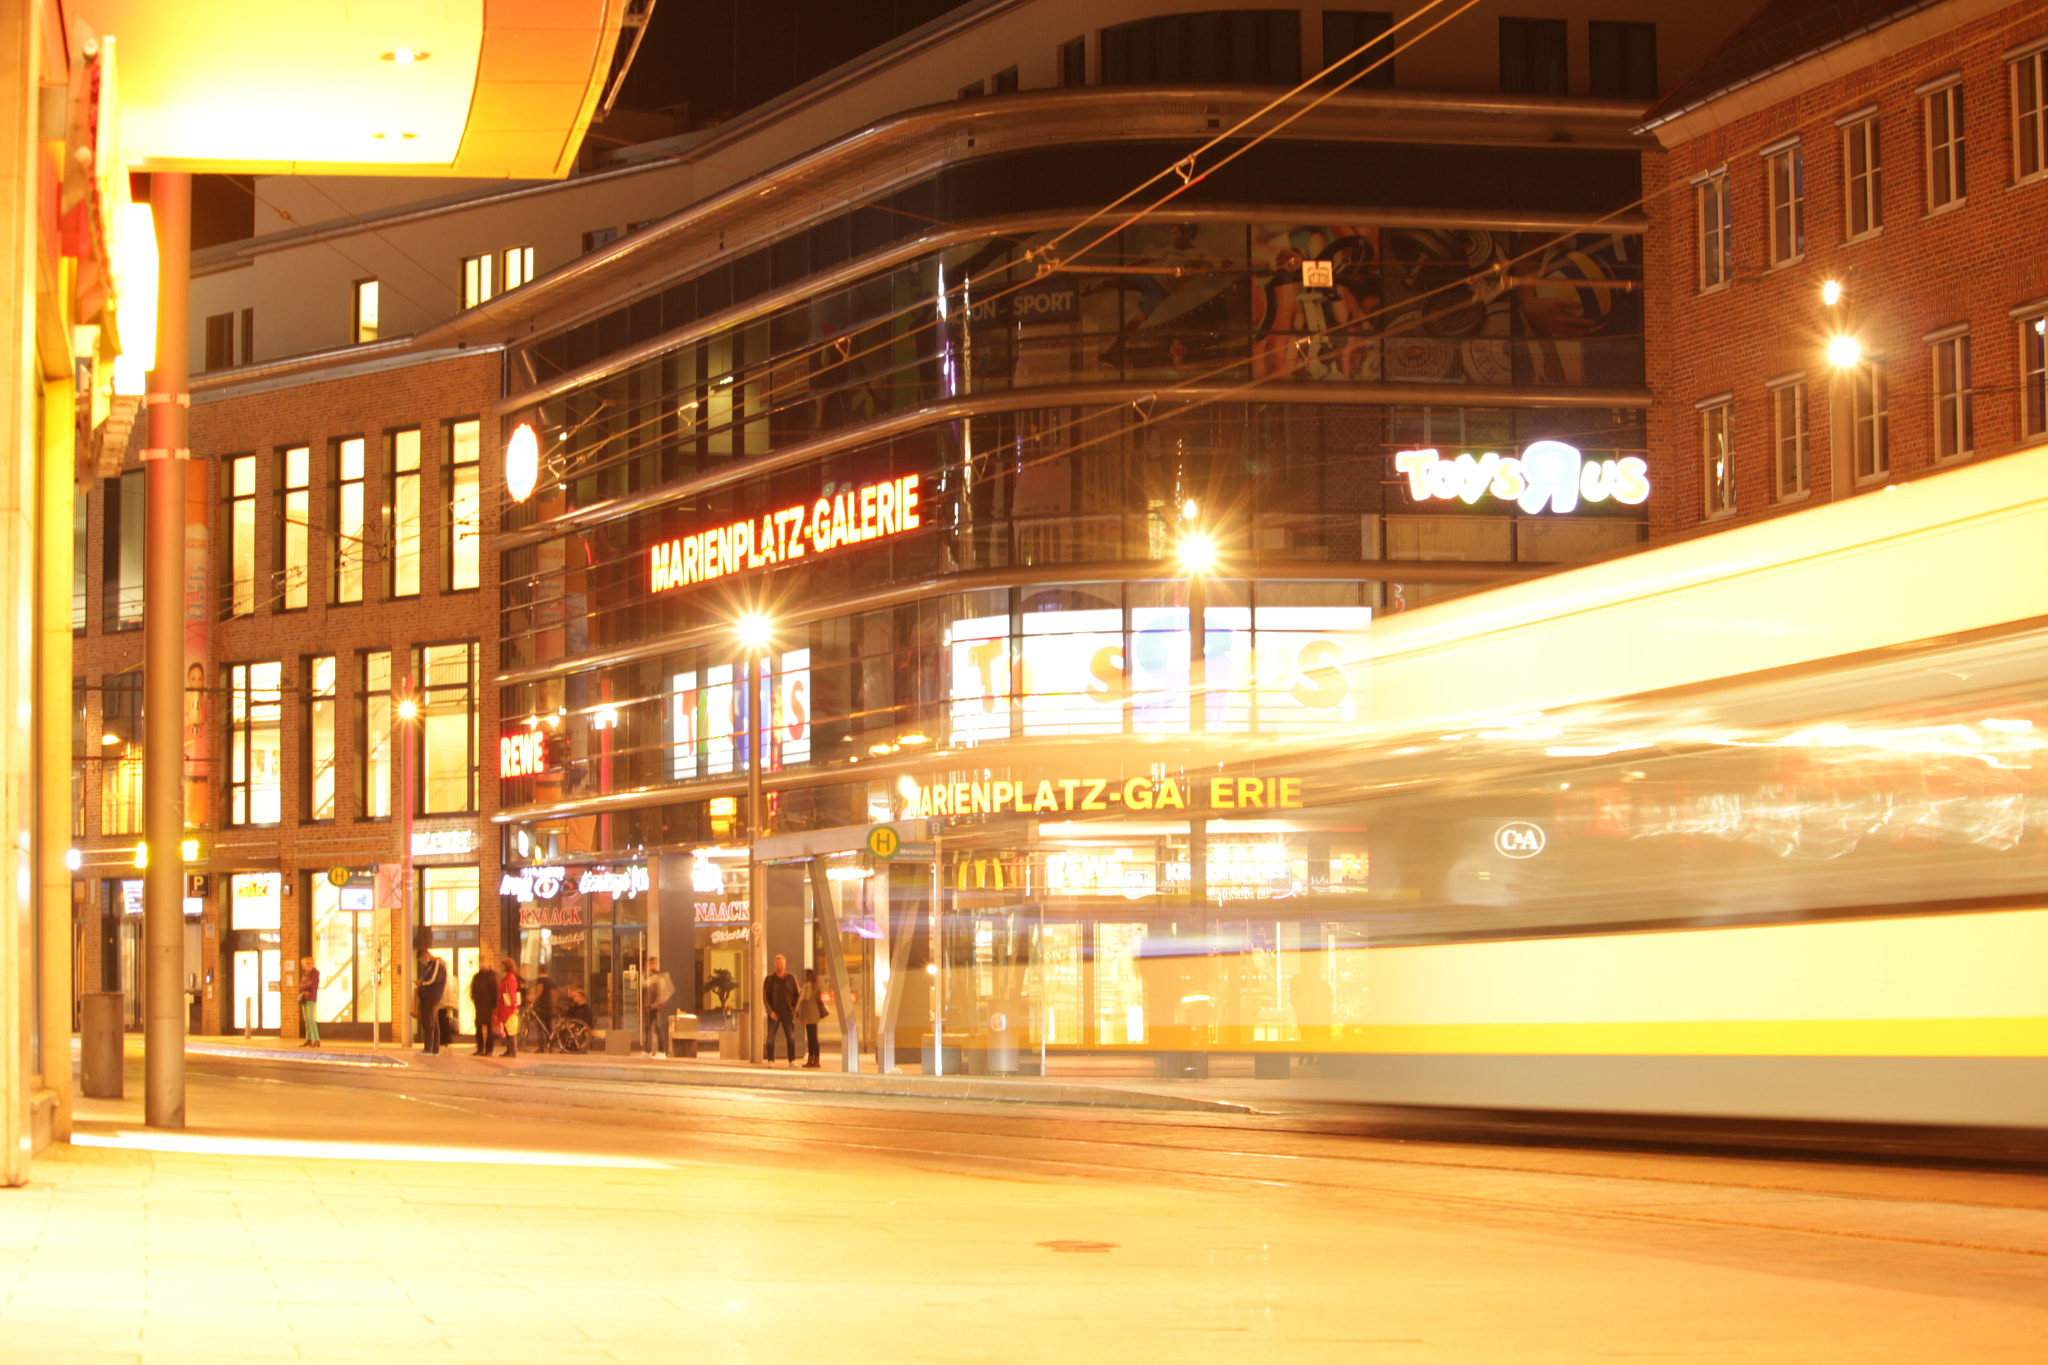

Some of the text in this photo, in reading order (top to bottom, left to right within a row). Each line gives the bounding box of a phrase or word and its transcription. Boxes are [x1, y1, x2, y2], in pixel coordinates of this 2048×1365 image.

[1014, 291, 1074, 315] SPORT
[651, 474, 919, 593] MARIENPLATZ-GALERIE
[501, 731, 544, 778] REWE
[908, 777, 1303, 817] MARIENPLATZ-GAERIE
[1501, 829, 1539, 850] C&A
[1047, 855, 1124, 878] REWE
[194, 876, 204, 891] P
[519, 907, 582, 926] KNAACK
